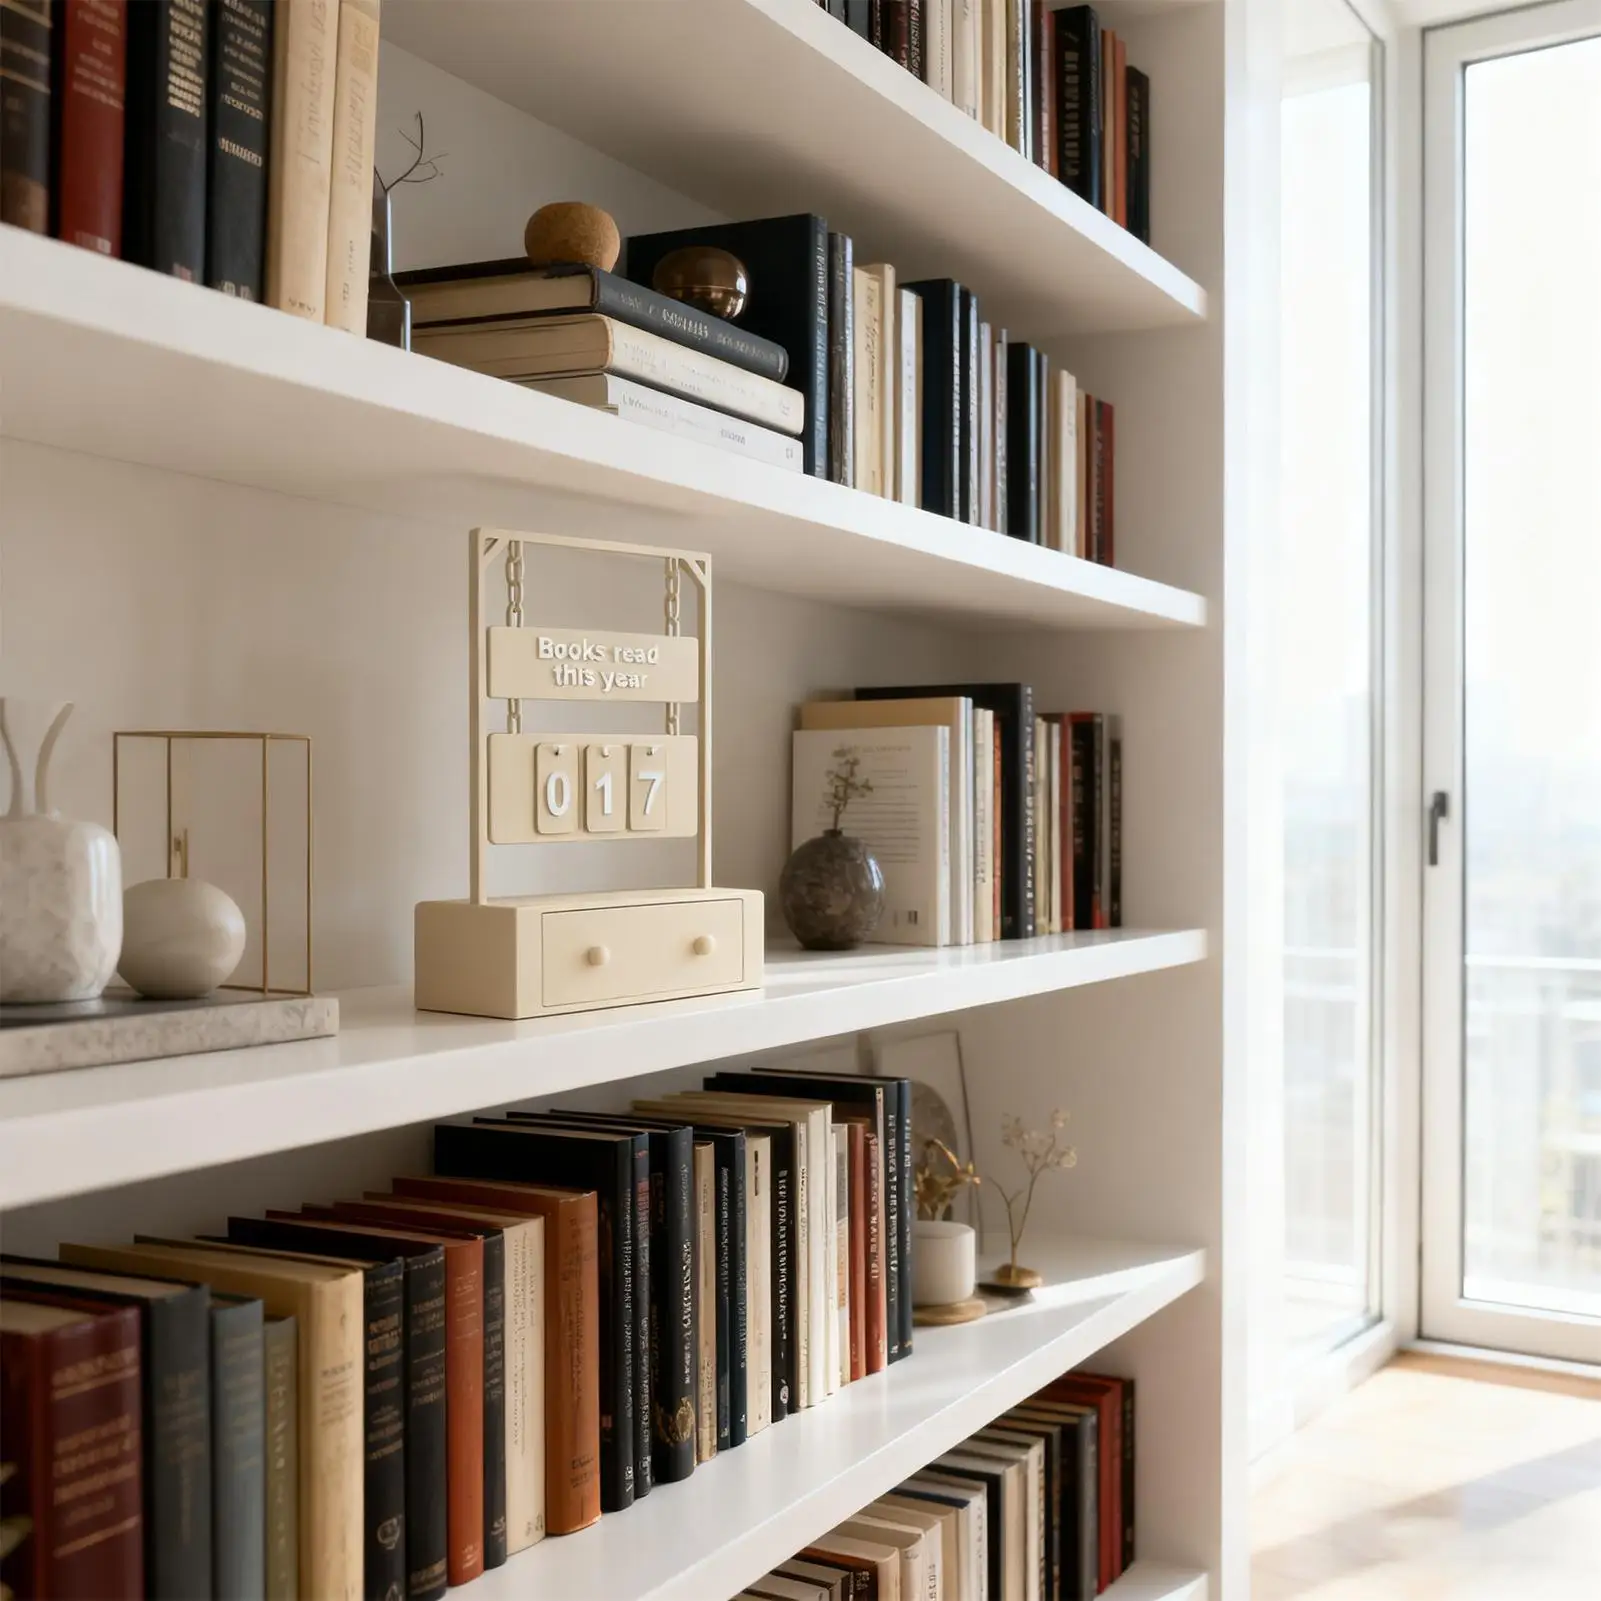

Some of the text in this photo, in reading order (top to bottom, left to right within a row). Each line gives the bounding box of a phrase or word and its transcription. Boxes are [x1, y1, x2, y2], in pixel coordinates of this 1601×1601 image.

[536, 636, 659, 665] Books read
[552, 664, 648, 692] this year
